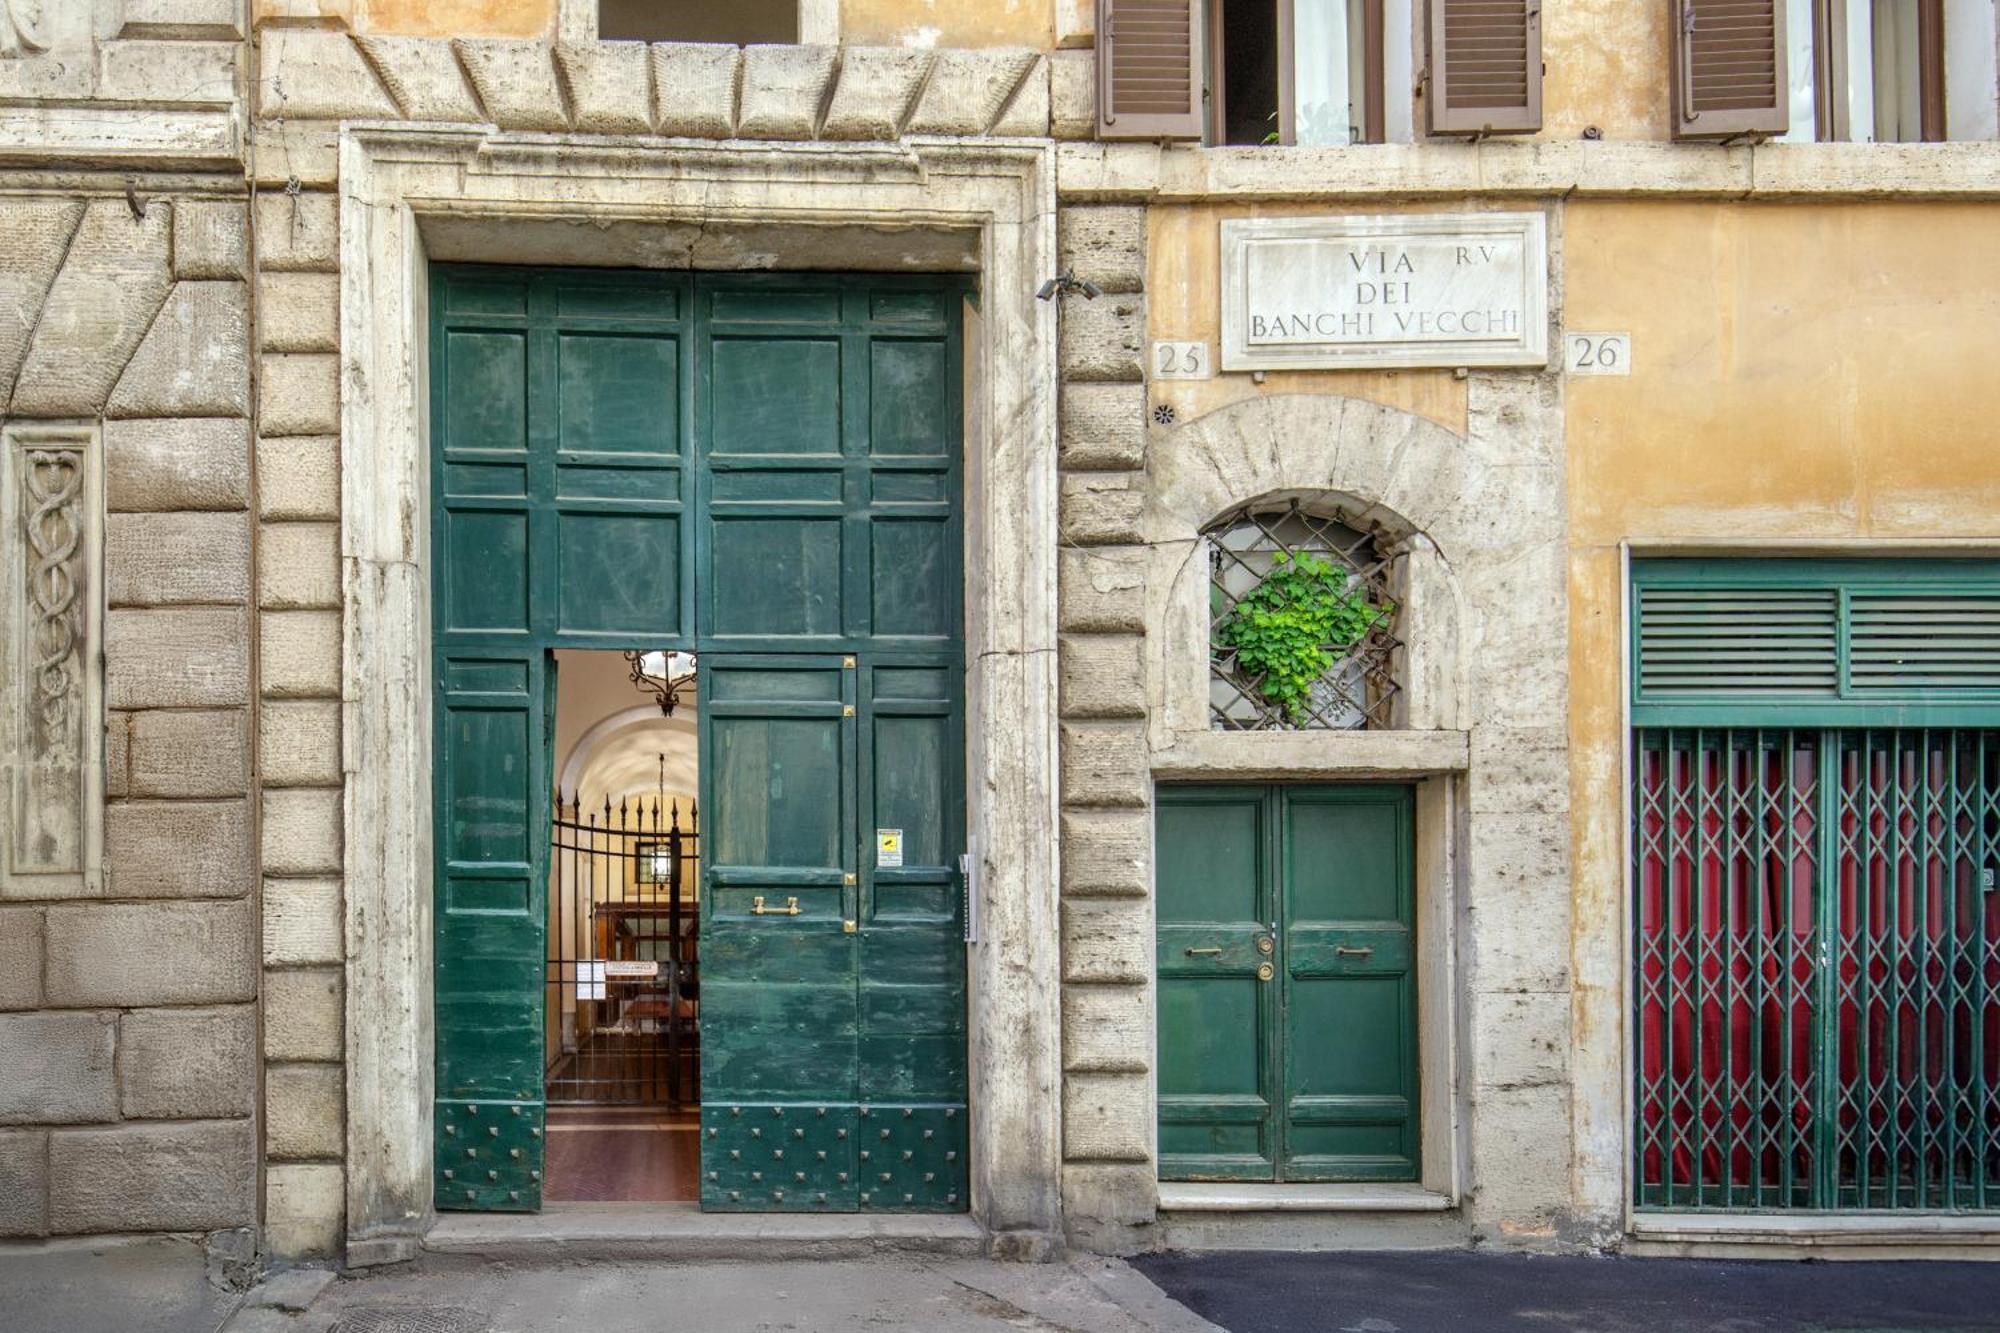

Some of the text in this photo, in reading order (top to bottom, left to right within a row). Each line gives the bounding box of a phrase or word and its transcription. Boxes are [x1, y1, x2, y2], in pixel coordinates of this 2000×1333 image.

[1349, 251, 1415, 274] VIA
[1356, 282, 1410, 305] DEI
[1251, 310, 1518, 338] BANCHI VECCHI
[1158, 344, 1200, 374] 25
[1575, 337, 1622, 368] 26
